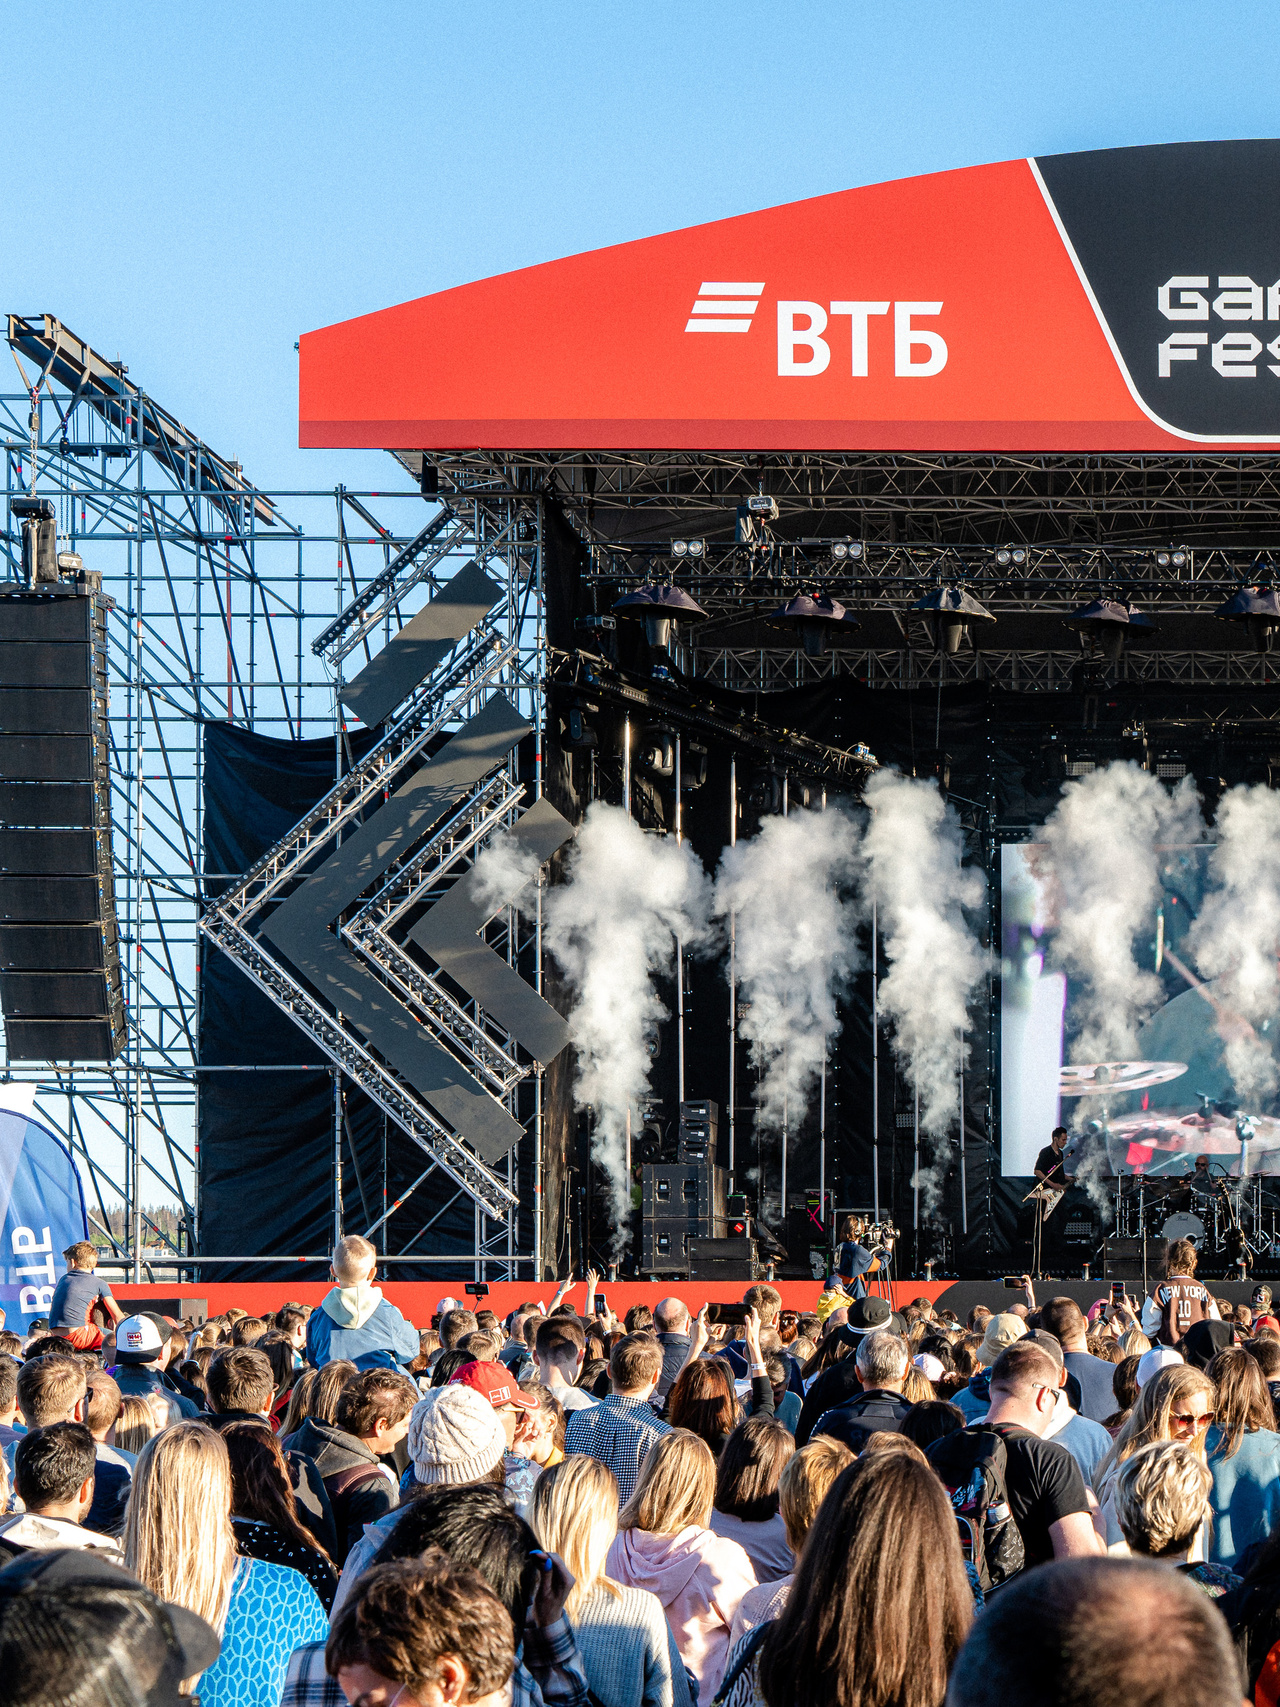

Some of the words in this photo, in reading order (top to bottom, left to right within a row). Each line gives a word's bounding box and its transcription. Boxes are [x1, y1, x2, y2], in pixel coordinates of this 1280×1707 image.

[777, 300, 948, 377] ВТБ
[1160, 1285, 1180, 1305] NEW
[1183, 1285, 1208, 1302] YORK
[1178, 1300, 1191, 1317] 10
